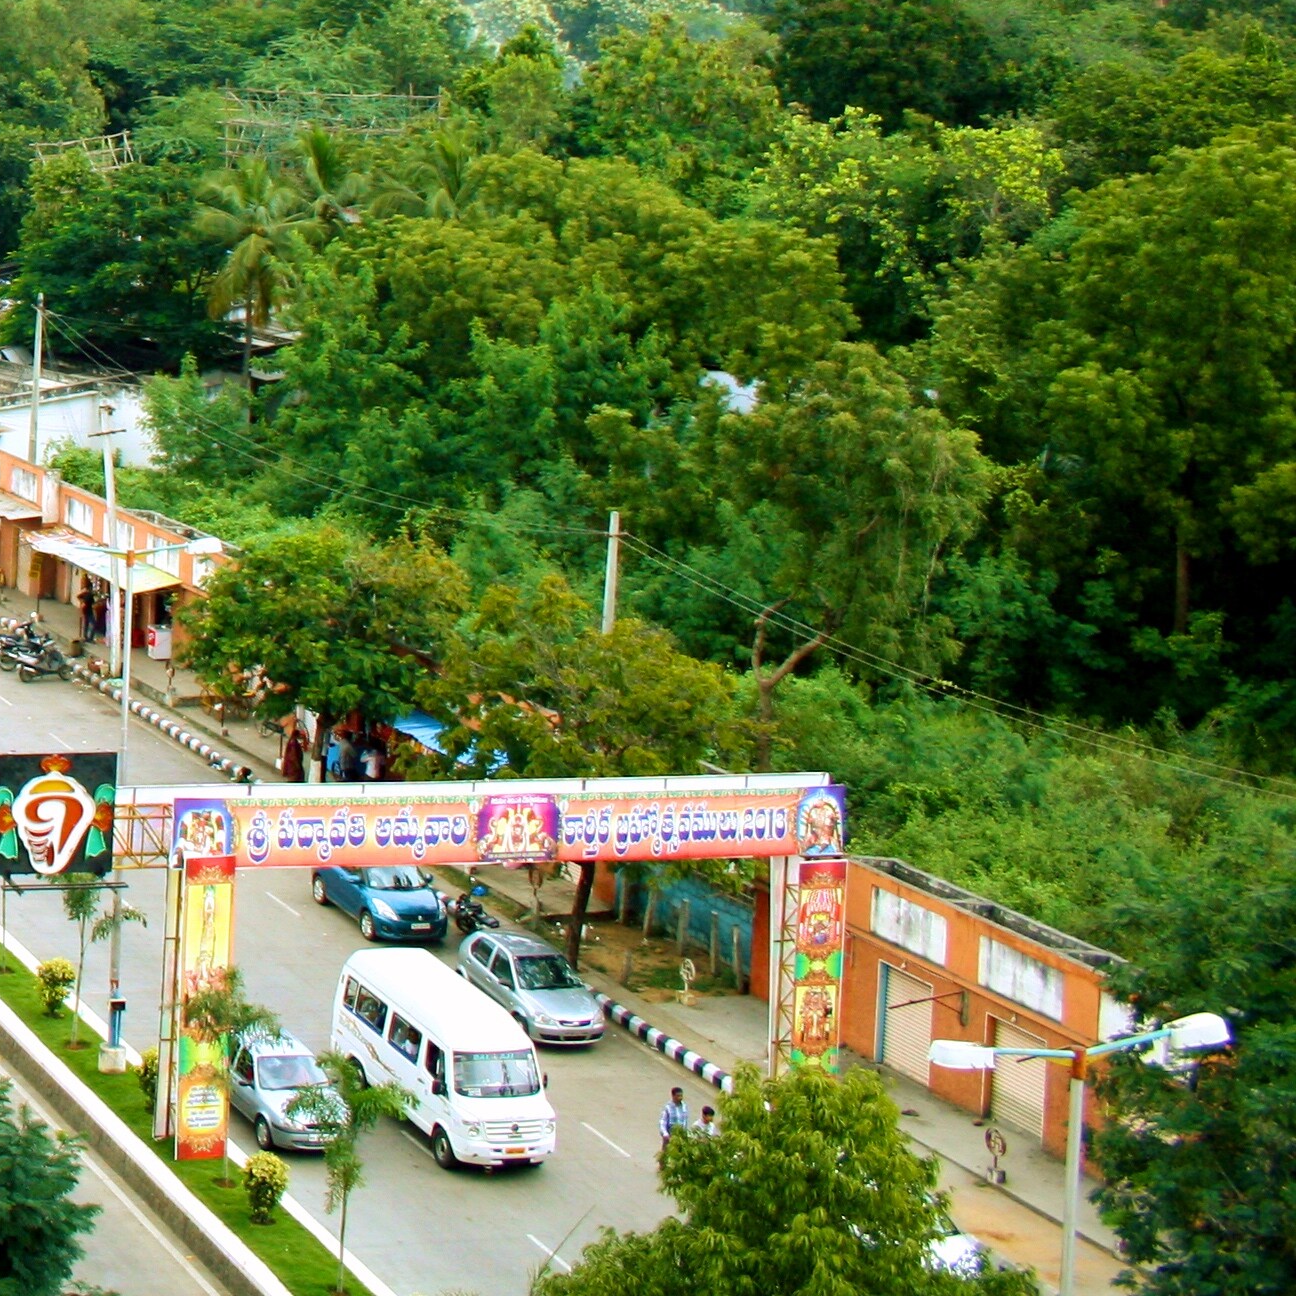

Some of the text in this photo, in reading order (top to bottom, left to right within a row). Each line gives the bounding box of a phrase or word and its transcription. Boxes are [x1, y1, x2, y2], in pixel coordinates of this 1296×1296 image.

[246, 805, 469, 863] శ్రీ పద్మావతి అమ్మవారి
